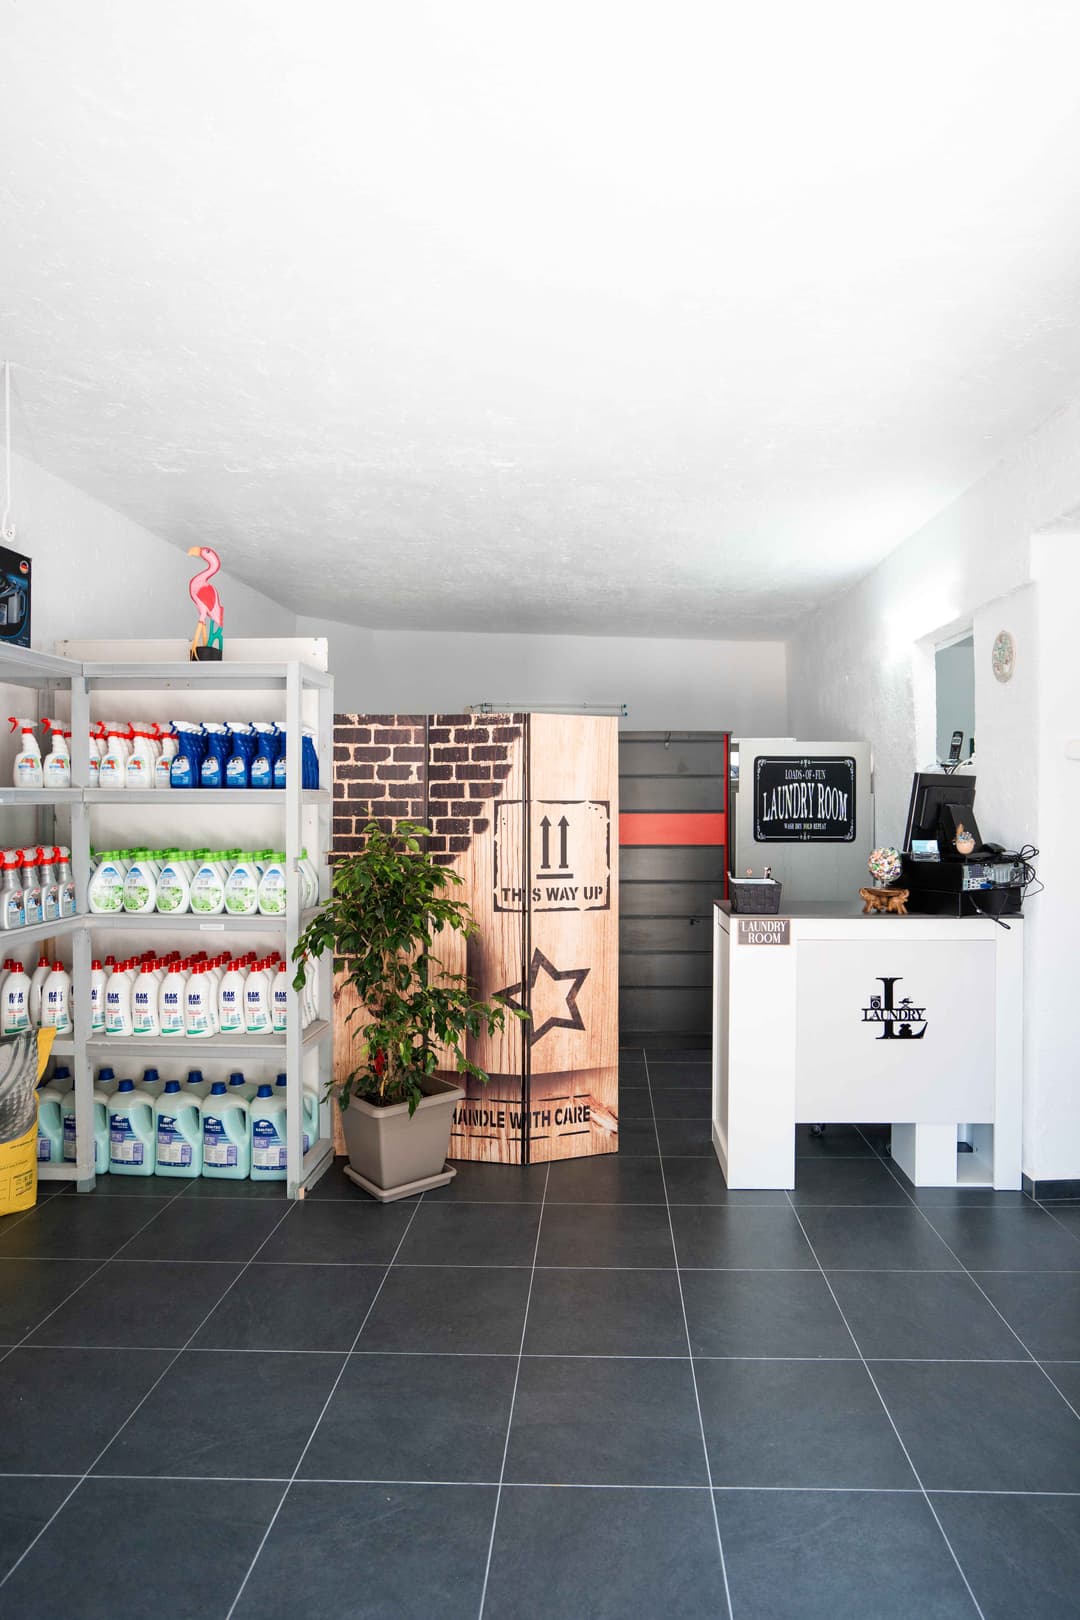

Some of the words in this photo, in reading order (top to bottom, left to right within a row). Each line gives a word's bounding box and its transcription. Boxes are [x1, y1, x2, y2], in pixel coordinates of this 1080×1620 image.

[763, 783, 815, 822] LAUNDRY
[817, 783, 848, 822] ROOM
[501, 887, 541, 902] THS
[546, 886, 579, 901] WAY
[583, 886, 603, 900] UP
[742, 920, 788, 932] LAUNDRY
[748, 932, 781, 944] ROOM
[862, 1008, 926, 1022] LAUNDRY
[555, 1105, 591, 1126] CARE
